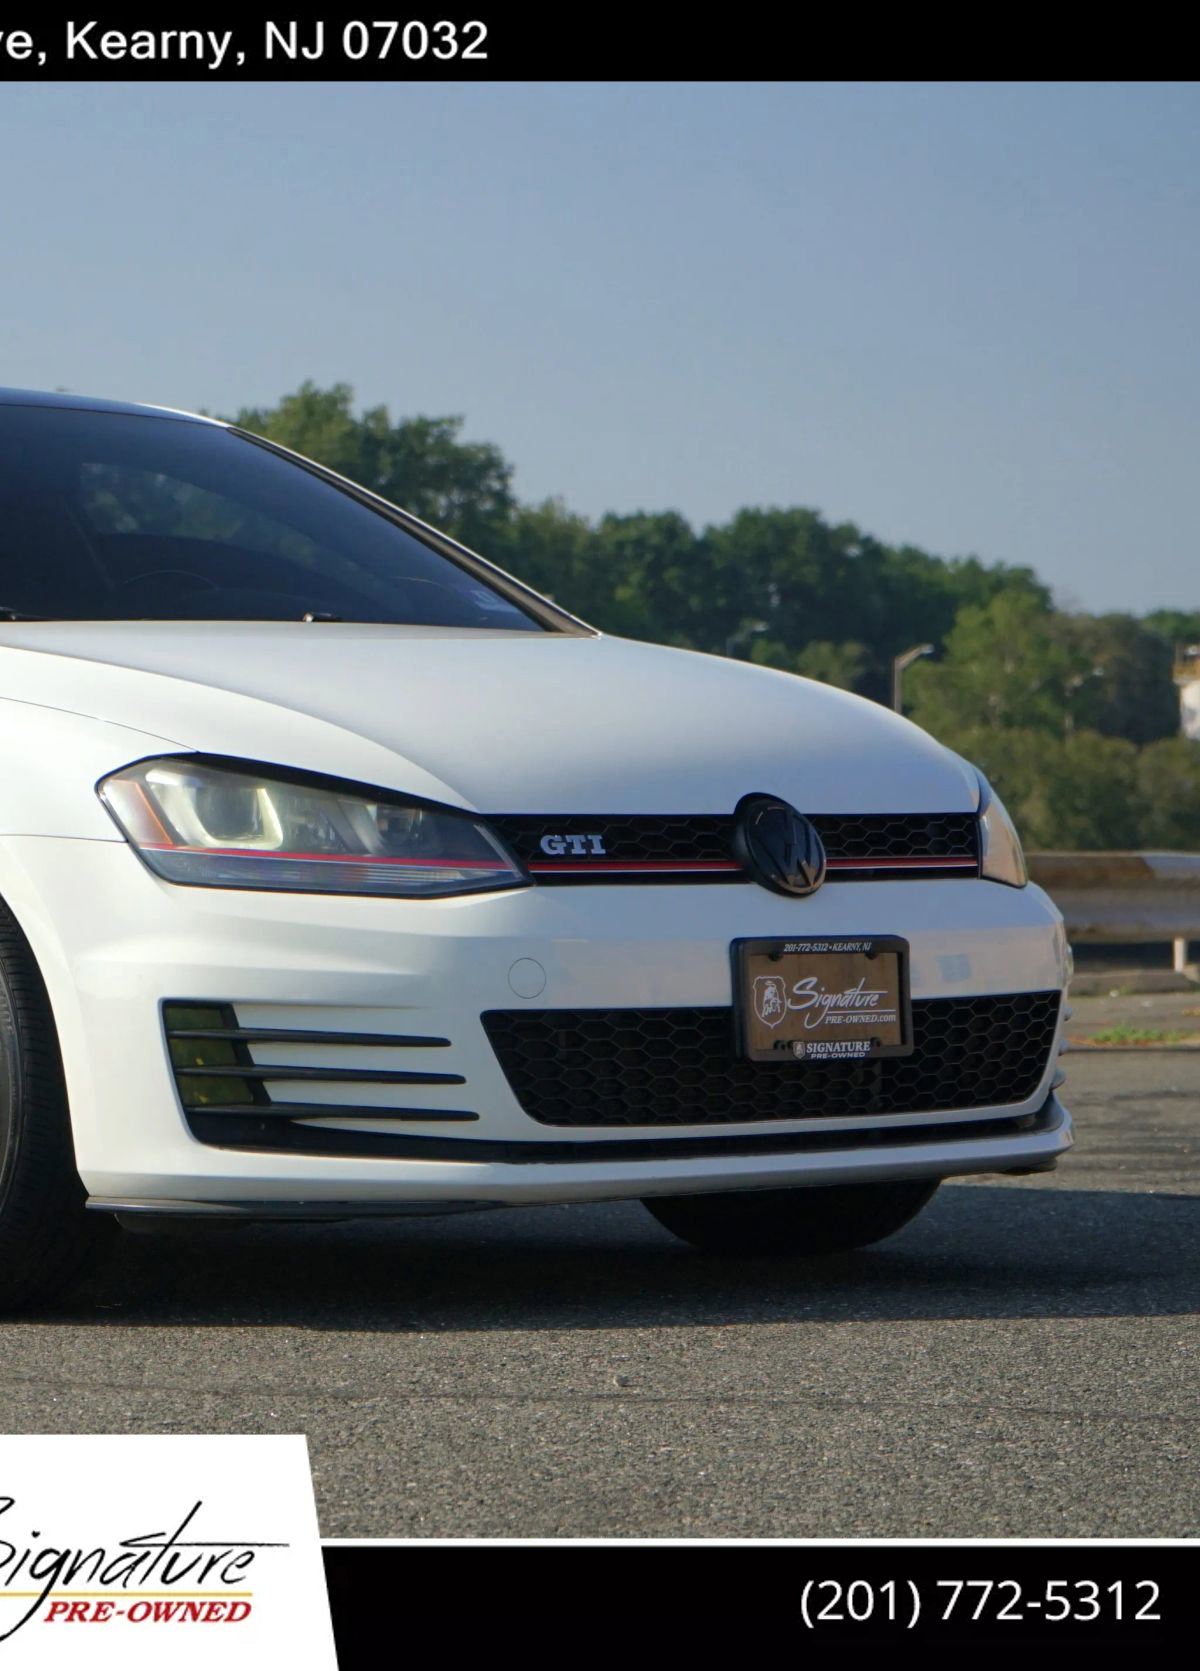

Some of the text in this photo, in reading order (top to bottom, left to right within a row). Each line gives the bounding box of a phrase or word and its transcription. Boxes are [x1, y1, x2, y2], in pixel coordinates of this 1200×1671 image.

[540, 834, 607, 855] GTI
[862, 942, 872, 951] NJ
[787, 976, 888, 1029] Signature
[824, 1014, 896, 1025] PRE-OWNED.com
[806, 1041, 871, 1053] SIGNATURE
[811, 1052, 866, 1060] PRE-OWNED
